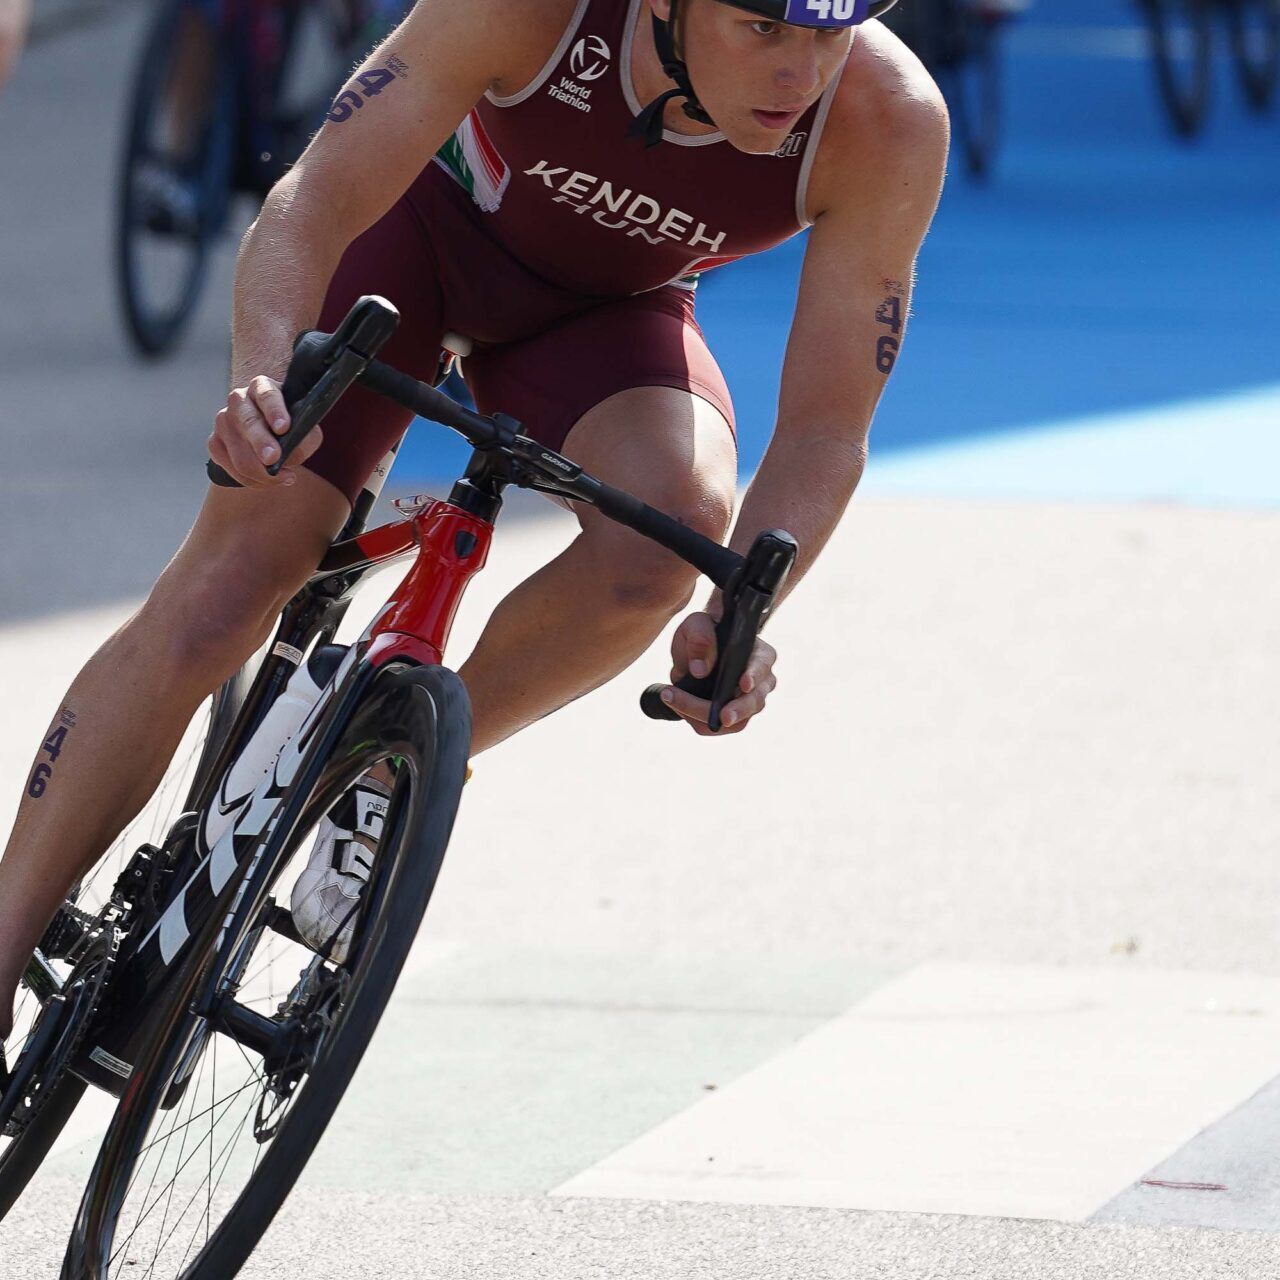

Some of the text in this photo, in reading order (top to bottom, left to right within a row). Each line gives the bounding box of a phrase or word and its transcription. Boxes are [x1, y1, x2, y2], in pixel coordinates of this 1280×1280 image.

[547, 84, 592, 113] Triathlon
[559, 76, 593, 100] World
[523, 159, 727, 253] KENDEH
[551, 195, 667, 245] HUN
